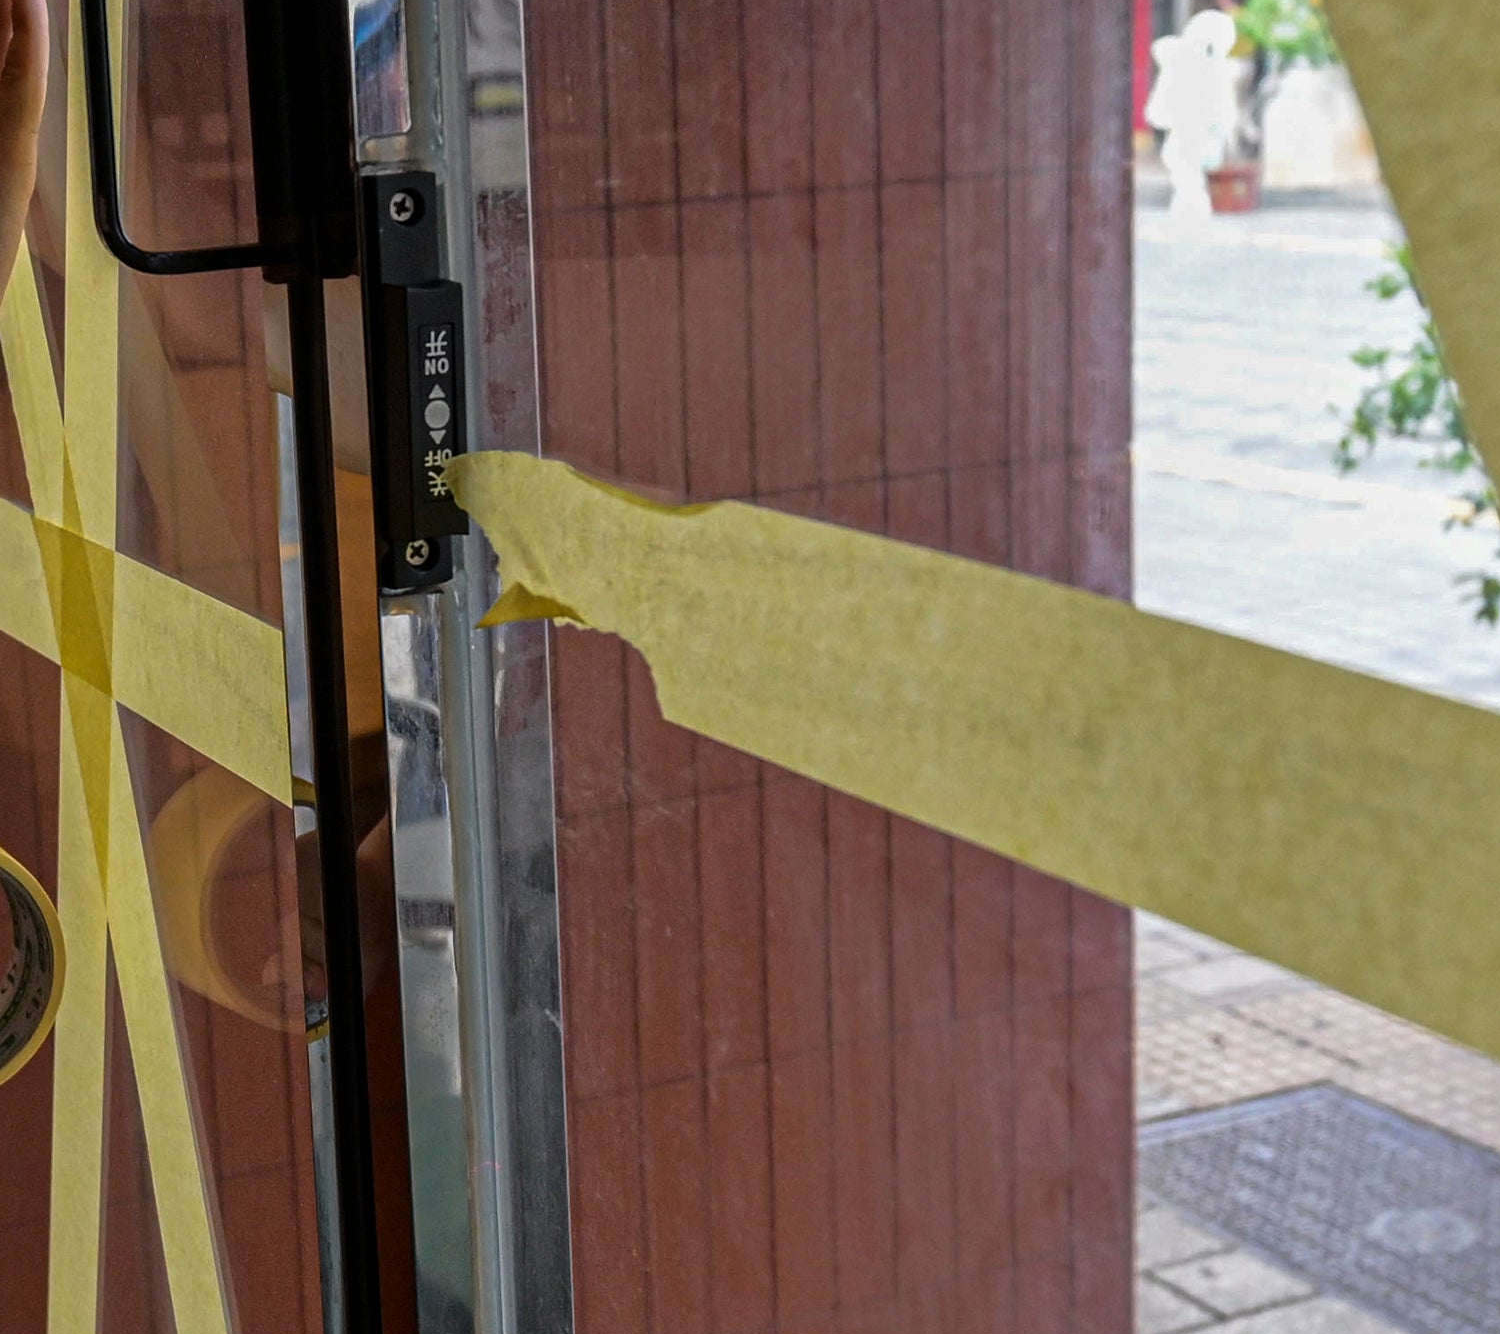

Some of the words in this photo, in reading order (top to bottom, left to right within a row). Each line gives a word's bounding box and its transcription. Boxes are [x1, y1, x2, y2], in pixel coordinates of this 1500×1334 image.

[425, 330, 448, 357] 开
[424, 357, 450, 376] ON
[424, 448, 453, 467] OFF
[427, 471, 449, 497] 关
